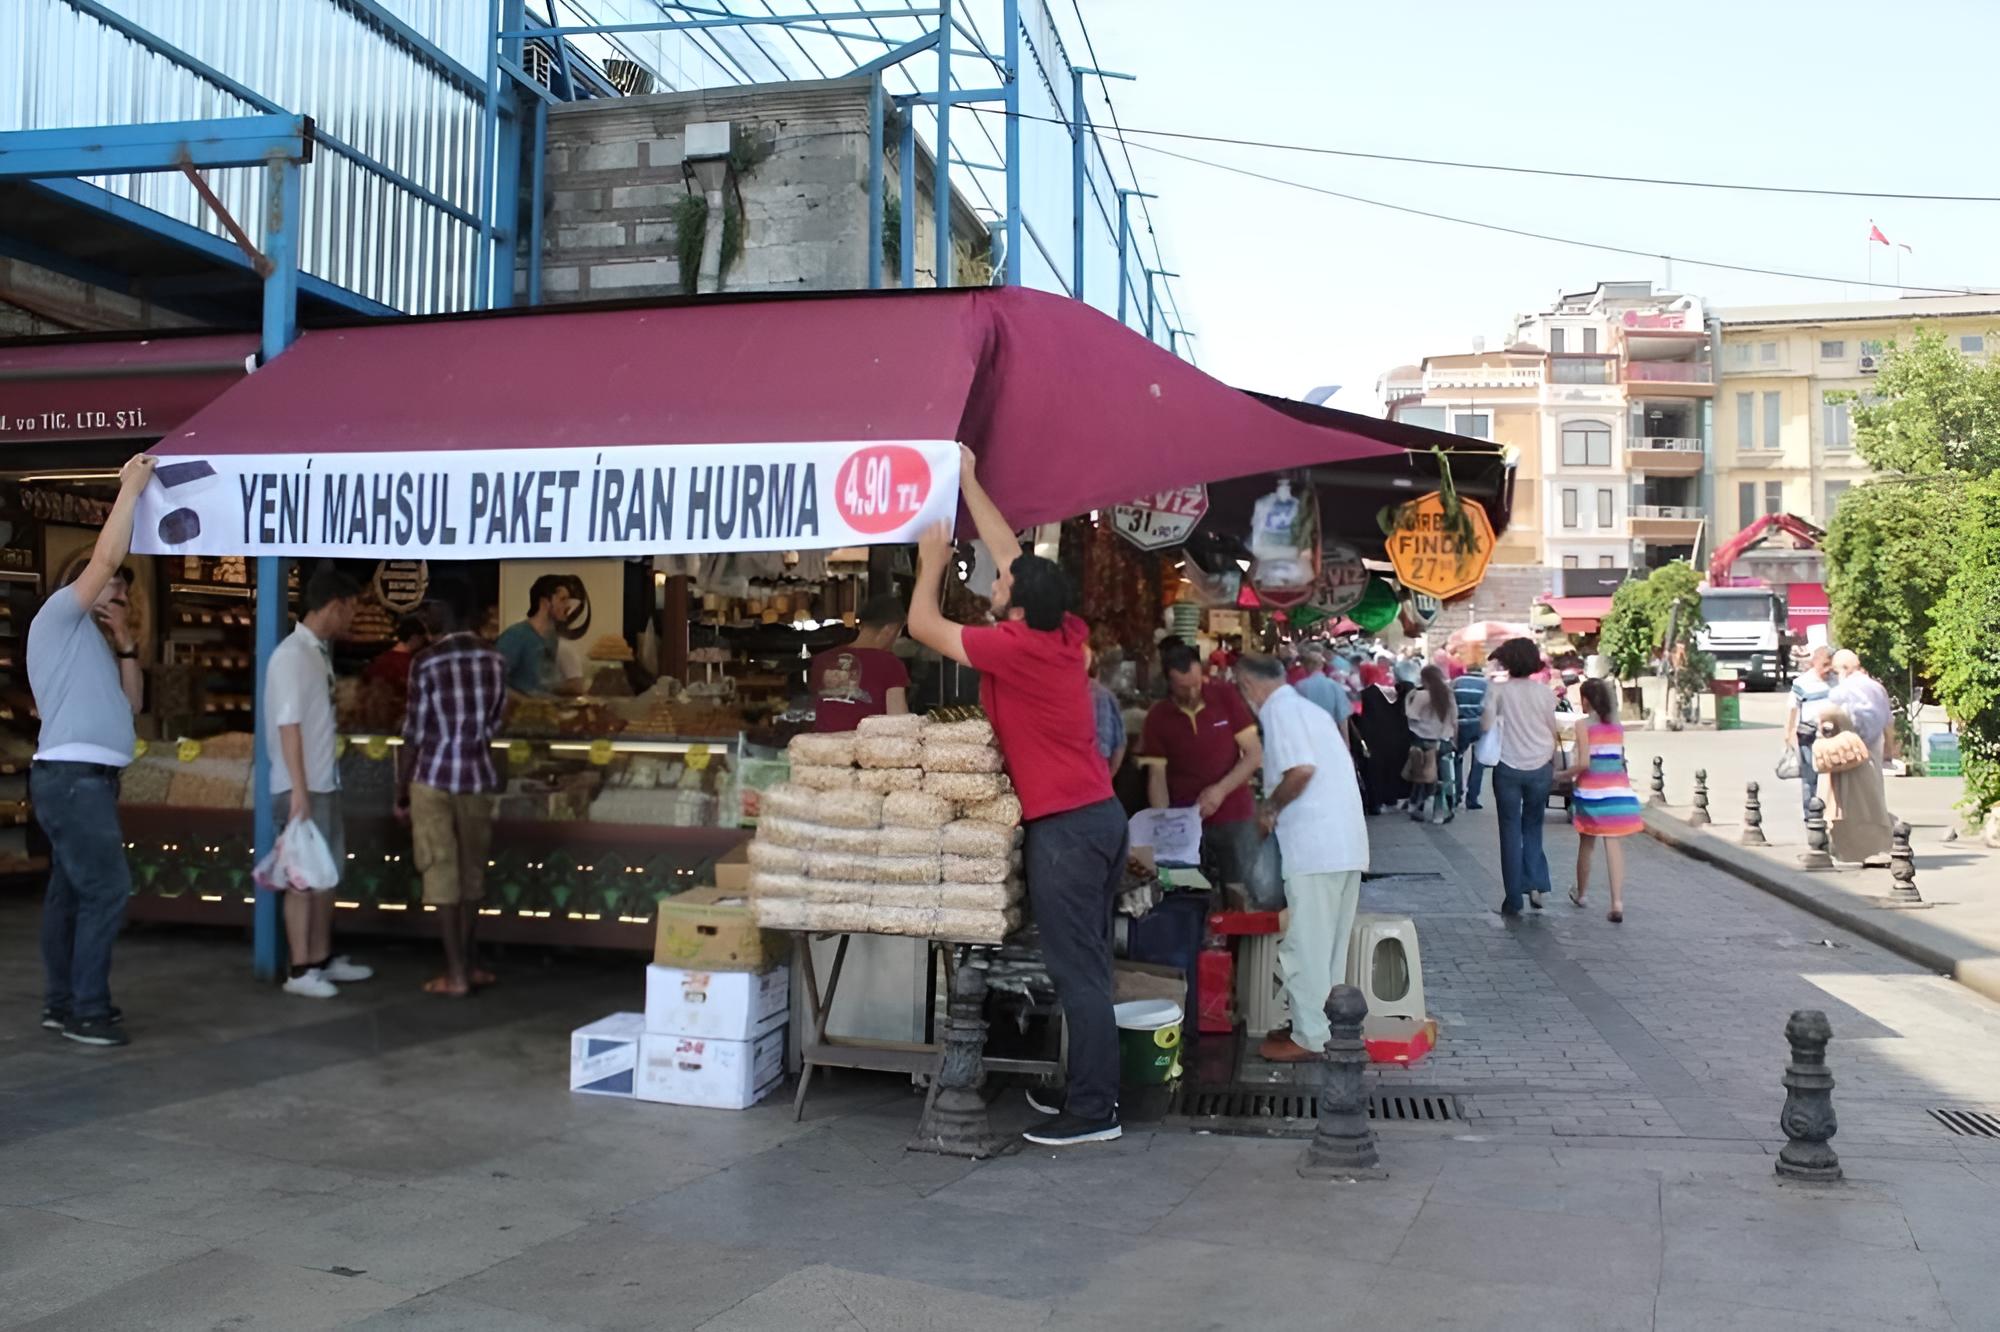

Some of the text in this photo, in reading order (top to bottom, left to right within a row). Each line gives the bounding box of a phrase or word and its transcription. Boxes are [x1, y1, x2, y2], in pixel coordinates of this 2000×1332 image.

[322, 471, 457, 546] MAHSUL
[468, 469, 580, 545] PAKET
[687, 462, 819, 541] HURMA
